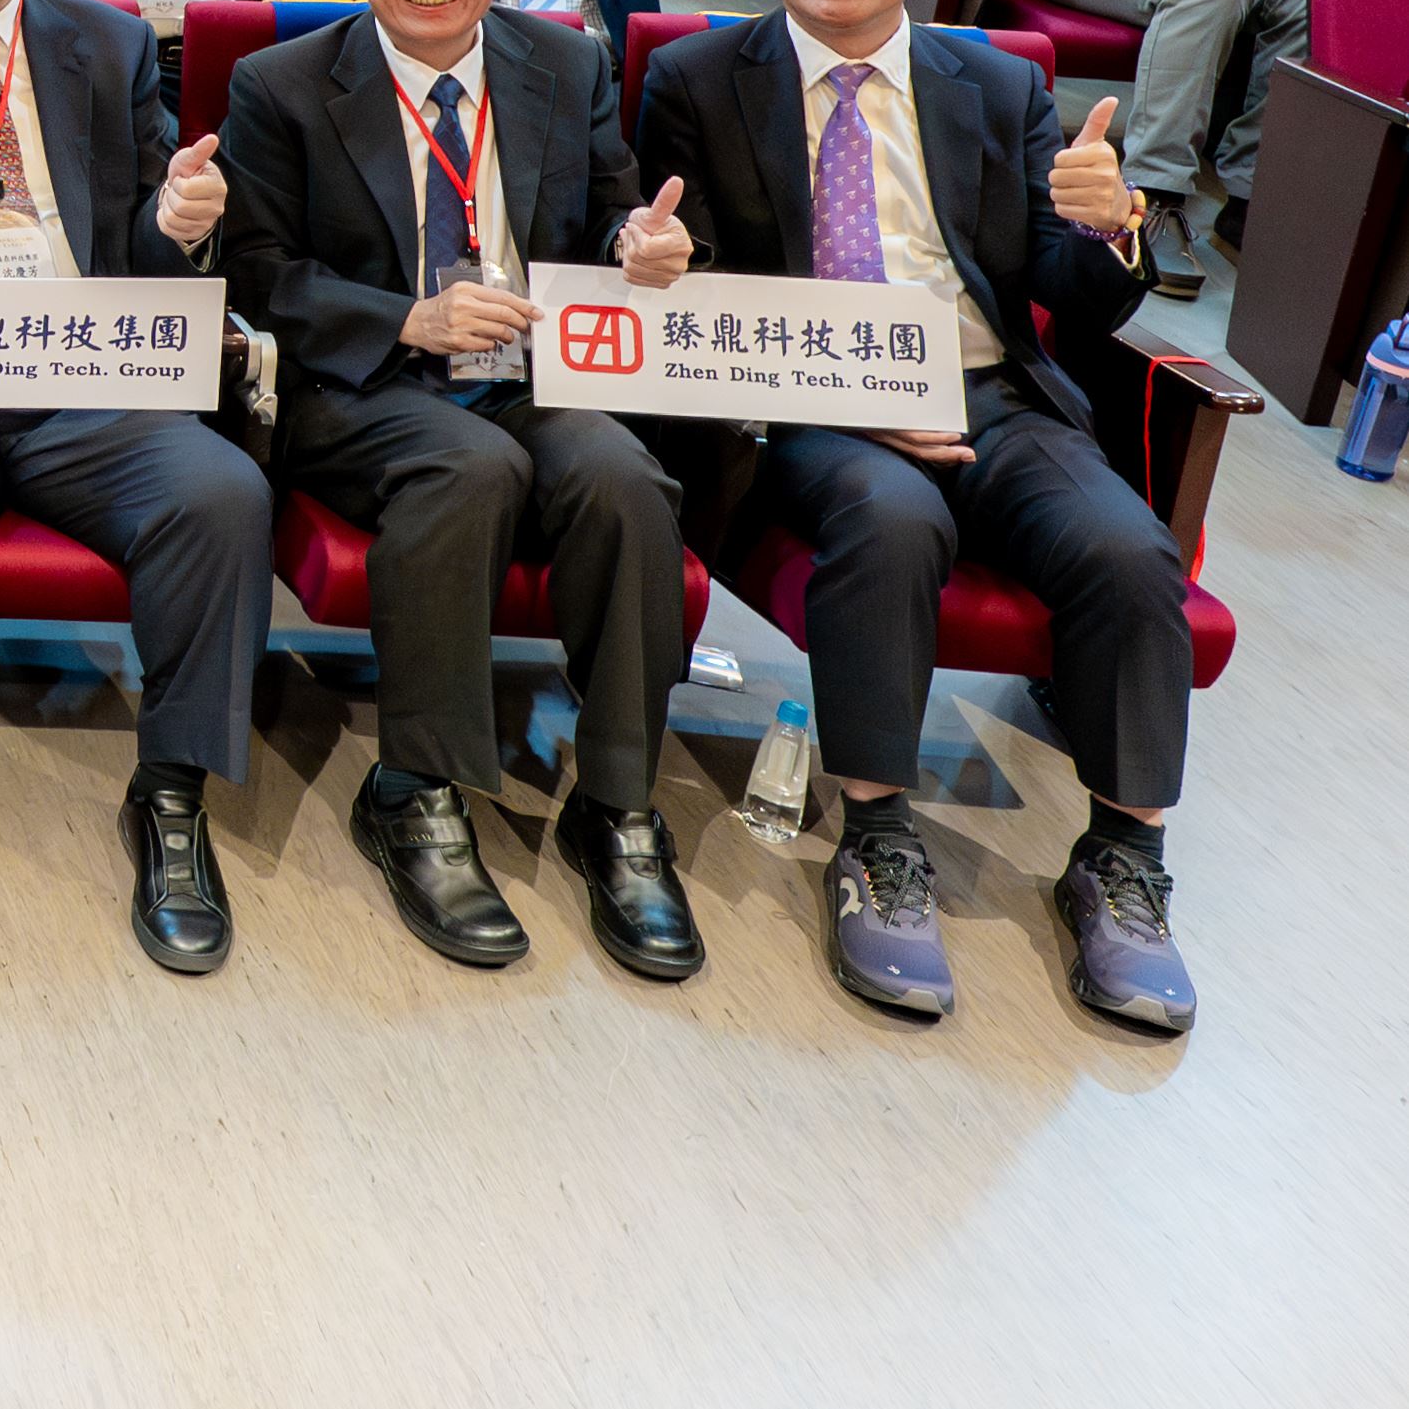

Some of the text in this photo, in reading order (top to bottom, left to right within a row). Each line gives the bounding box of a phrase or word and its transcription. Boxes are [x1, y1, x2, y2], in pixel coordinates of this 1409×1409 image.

[662, 311, 927, 365] 臻鼎科技集團
[49, 361, 108, 377] Tech.
[119, 362, 186, 381] Group
[664, 362, 930, 397] Zhen Ding Tech. Group
